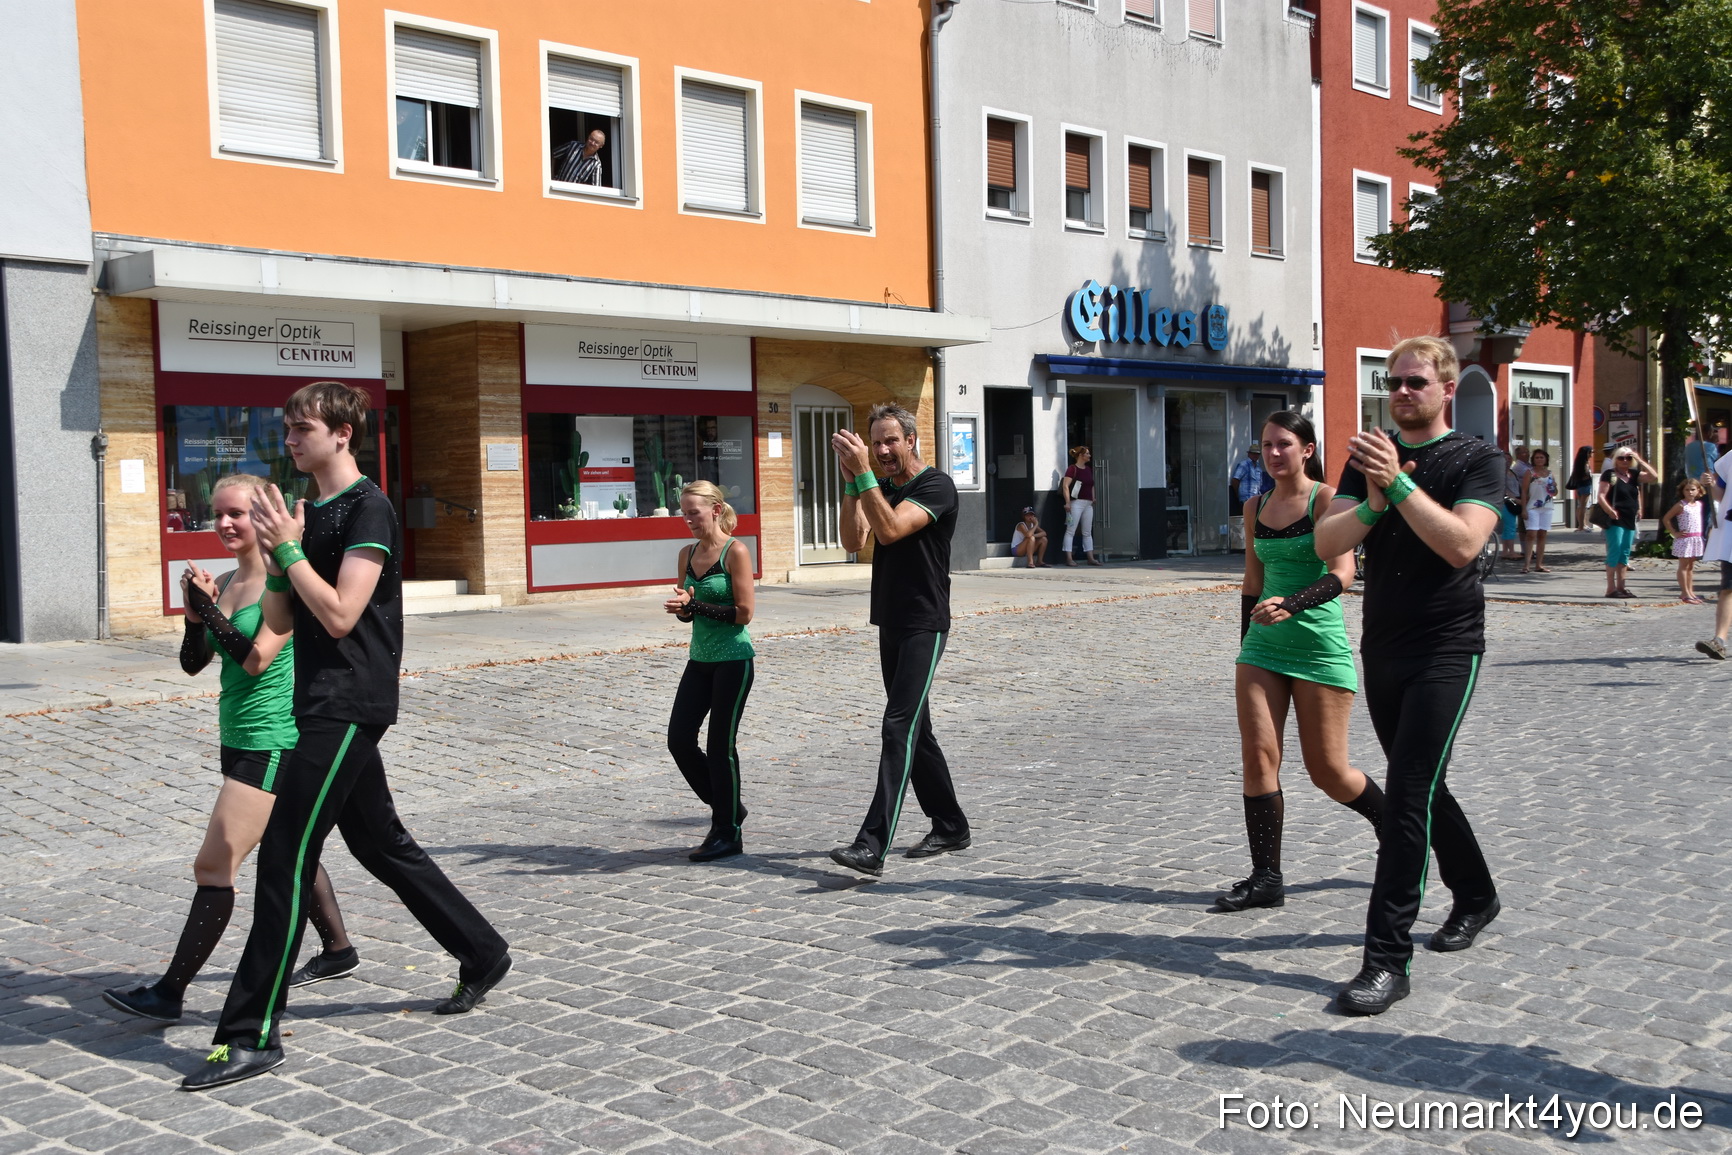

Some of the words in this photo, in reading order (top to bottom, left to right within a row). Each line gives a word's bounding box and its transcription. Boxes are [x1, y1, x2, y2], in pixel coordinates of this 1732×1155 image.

[188, 318, 274, 340] Reissinger
[280, 323, 322, 342] Optik
[312, 339, 321, 347] im
[578, 340, 640, 358] Reissinger
[643, 344, 674, 360] Optik
[279, 347, 353, 363] CENTRUM
[643, 363, 697, 377] CENTRUM
[1371, 370, 1389, 391] fiel
[958, 384, 967, 396] 31
[1519, 380, 1554, 401] fielmann
[768, 402, 779, 414] 30
[184, 438, 216, 446] Reissinger
[217, 438, 233, 447] Optik
